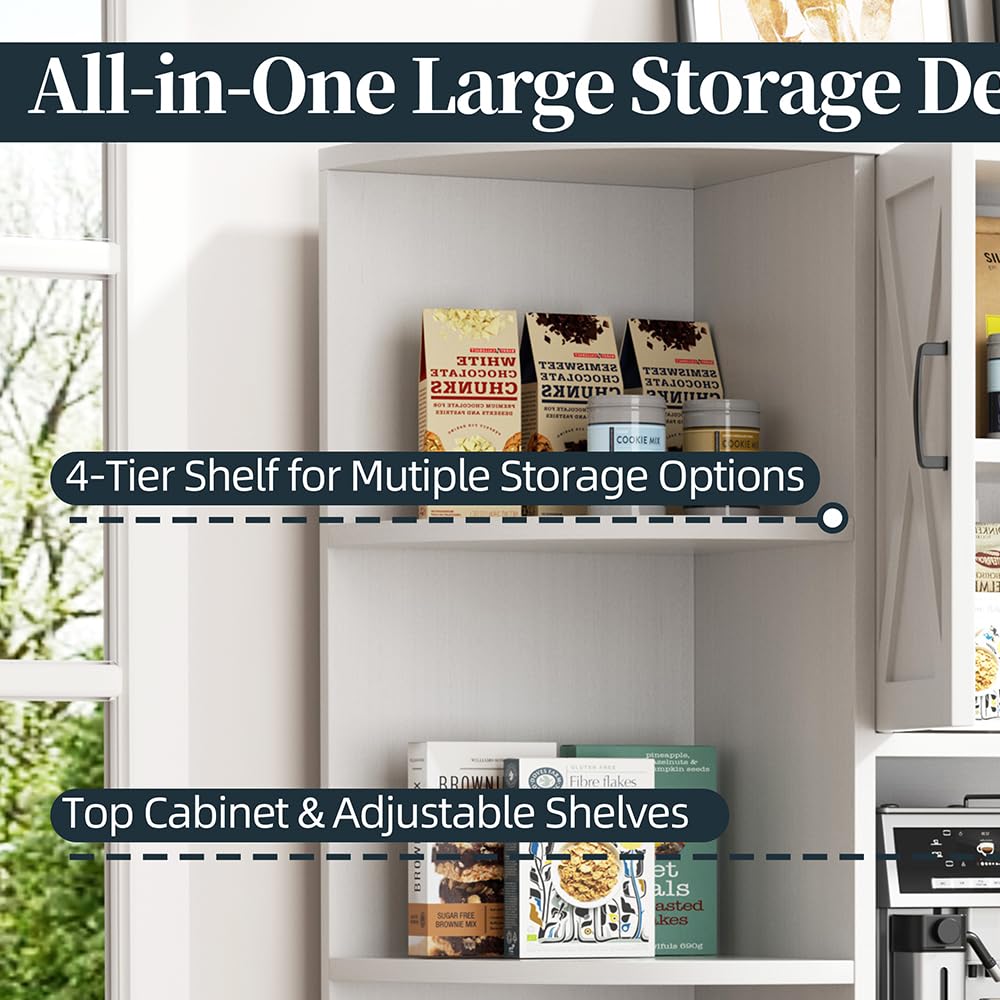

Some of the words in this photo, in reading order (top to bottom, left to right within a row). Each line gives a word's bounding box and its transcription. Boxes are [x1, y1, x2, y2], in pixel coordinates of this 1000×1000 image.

[616, 436, 647, 444] COOKIE
[722, 440, 751, 448] COOKIE
[646, 752, 690, 760] pineapple,
[439, 775, 505, 789] BROWNI
[570, 775, 600, 788] Fibre
[603, 775, 638, 788] flakes
[655, 861, 678, 878] et
[655, 880, 690, 896] als
[655, 899, 704, 911] asted
[680, 943, 703, 951] 690g
